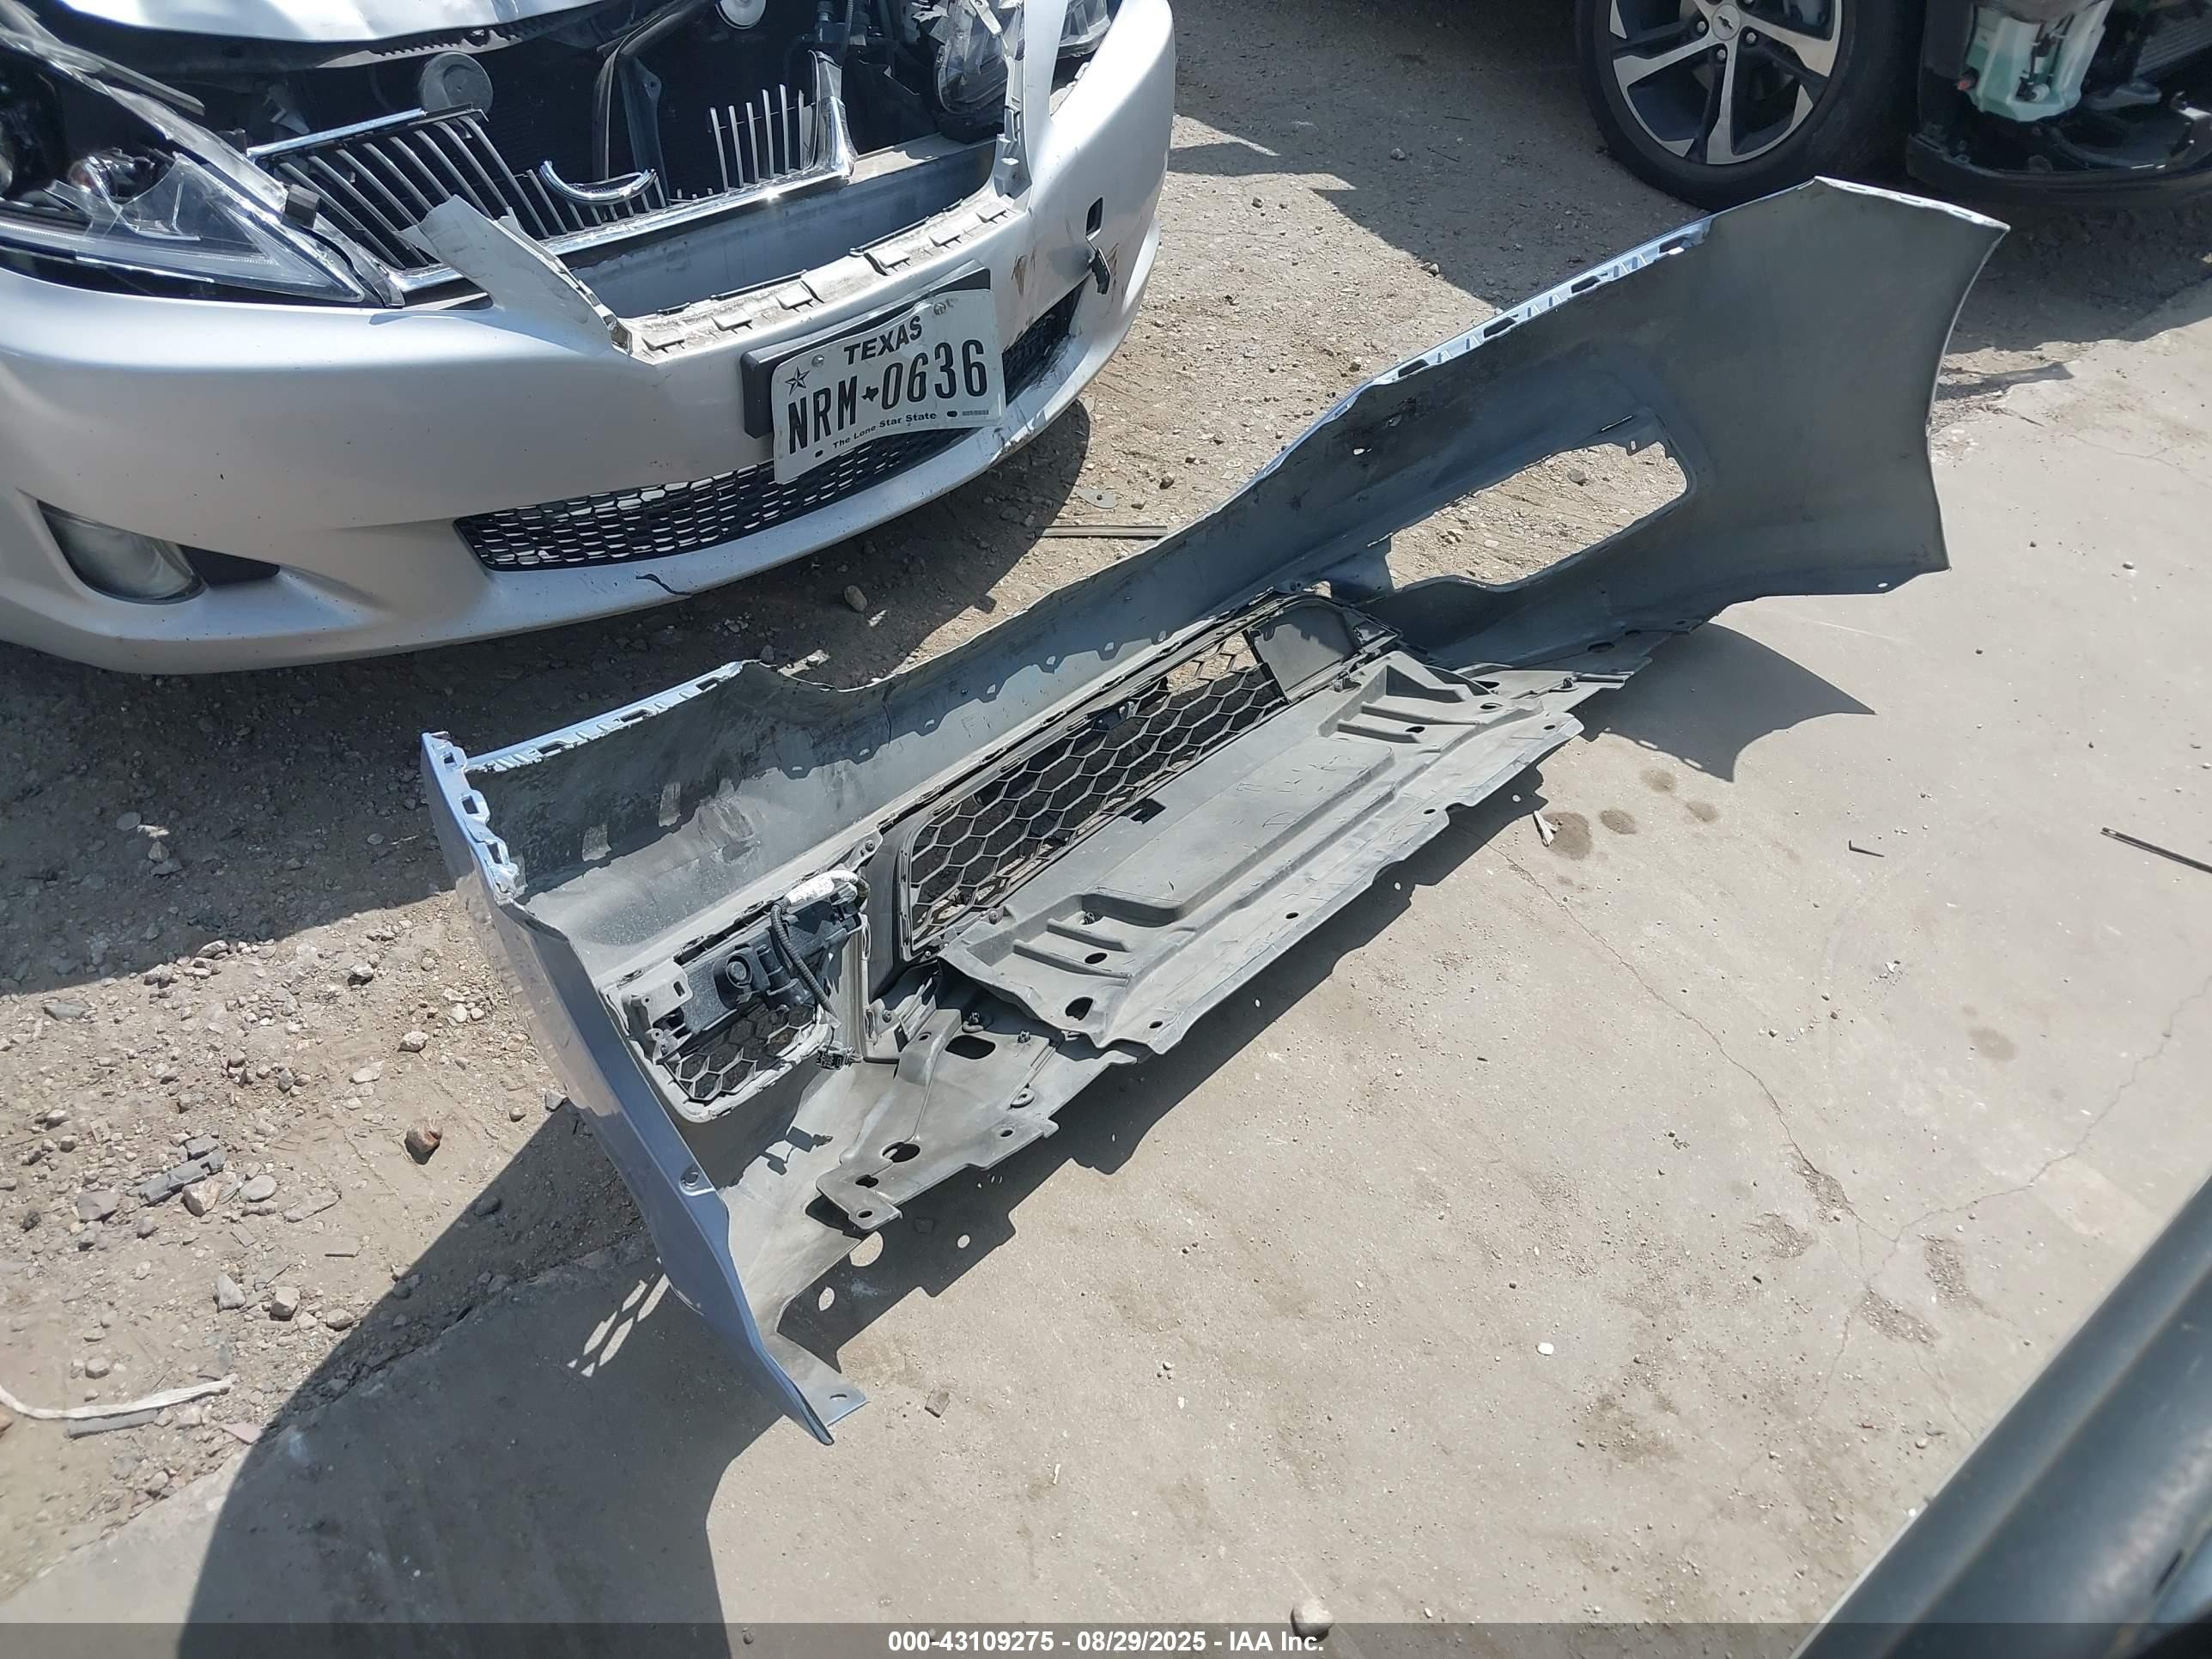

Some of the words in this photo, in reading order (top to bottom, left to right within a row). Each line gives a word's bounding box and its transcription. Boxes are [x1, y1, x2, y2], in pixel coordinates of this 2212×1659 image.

[843, 315, 923, 366] TEXAS
[833, 438, 850, 449] The
[854, 425, 877, 440] Lone
[878, 416, 902, 428] Star
[905, 411, 938, 422] State
